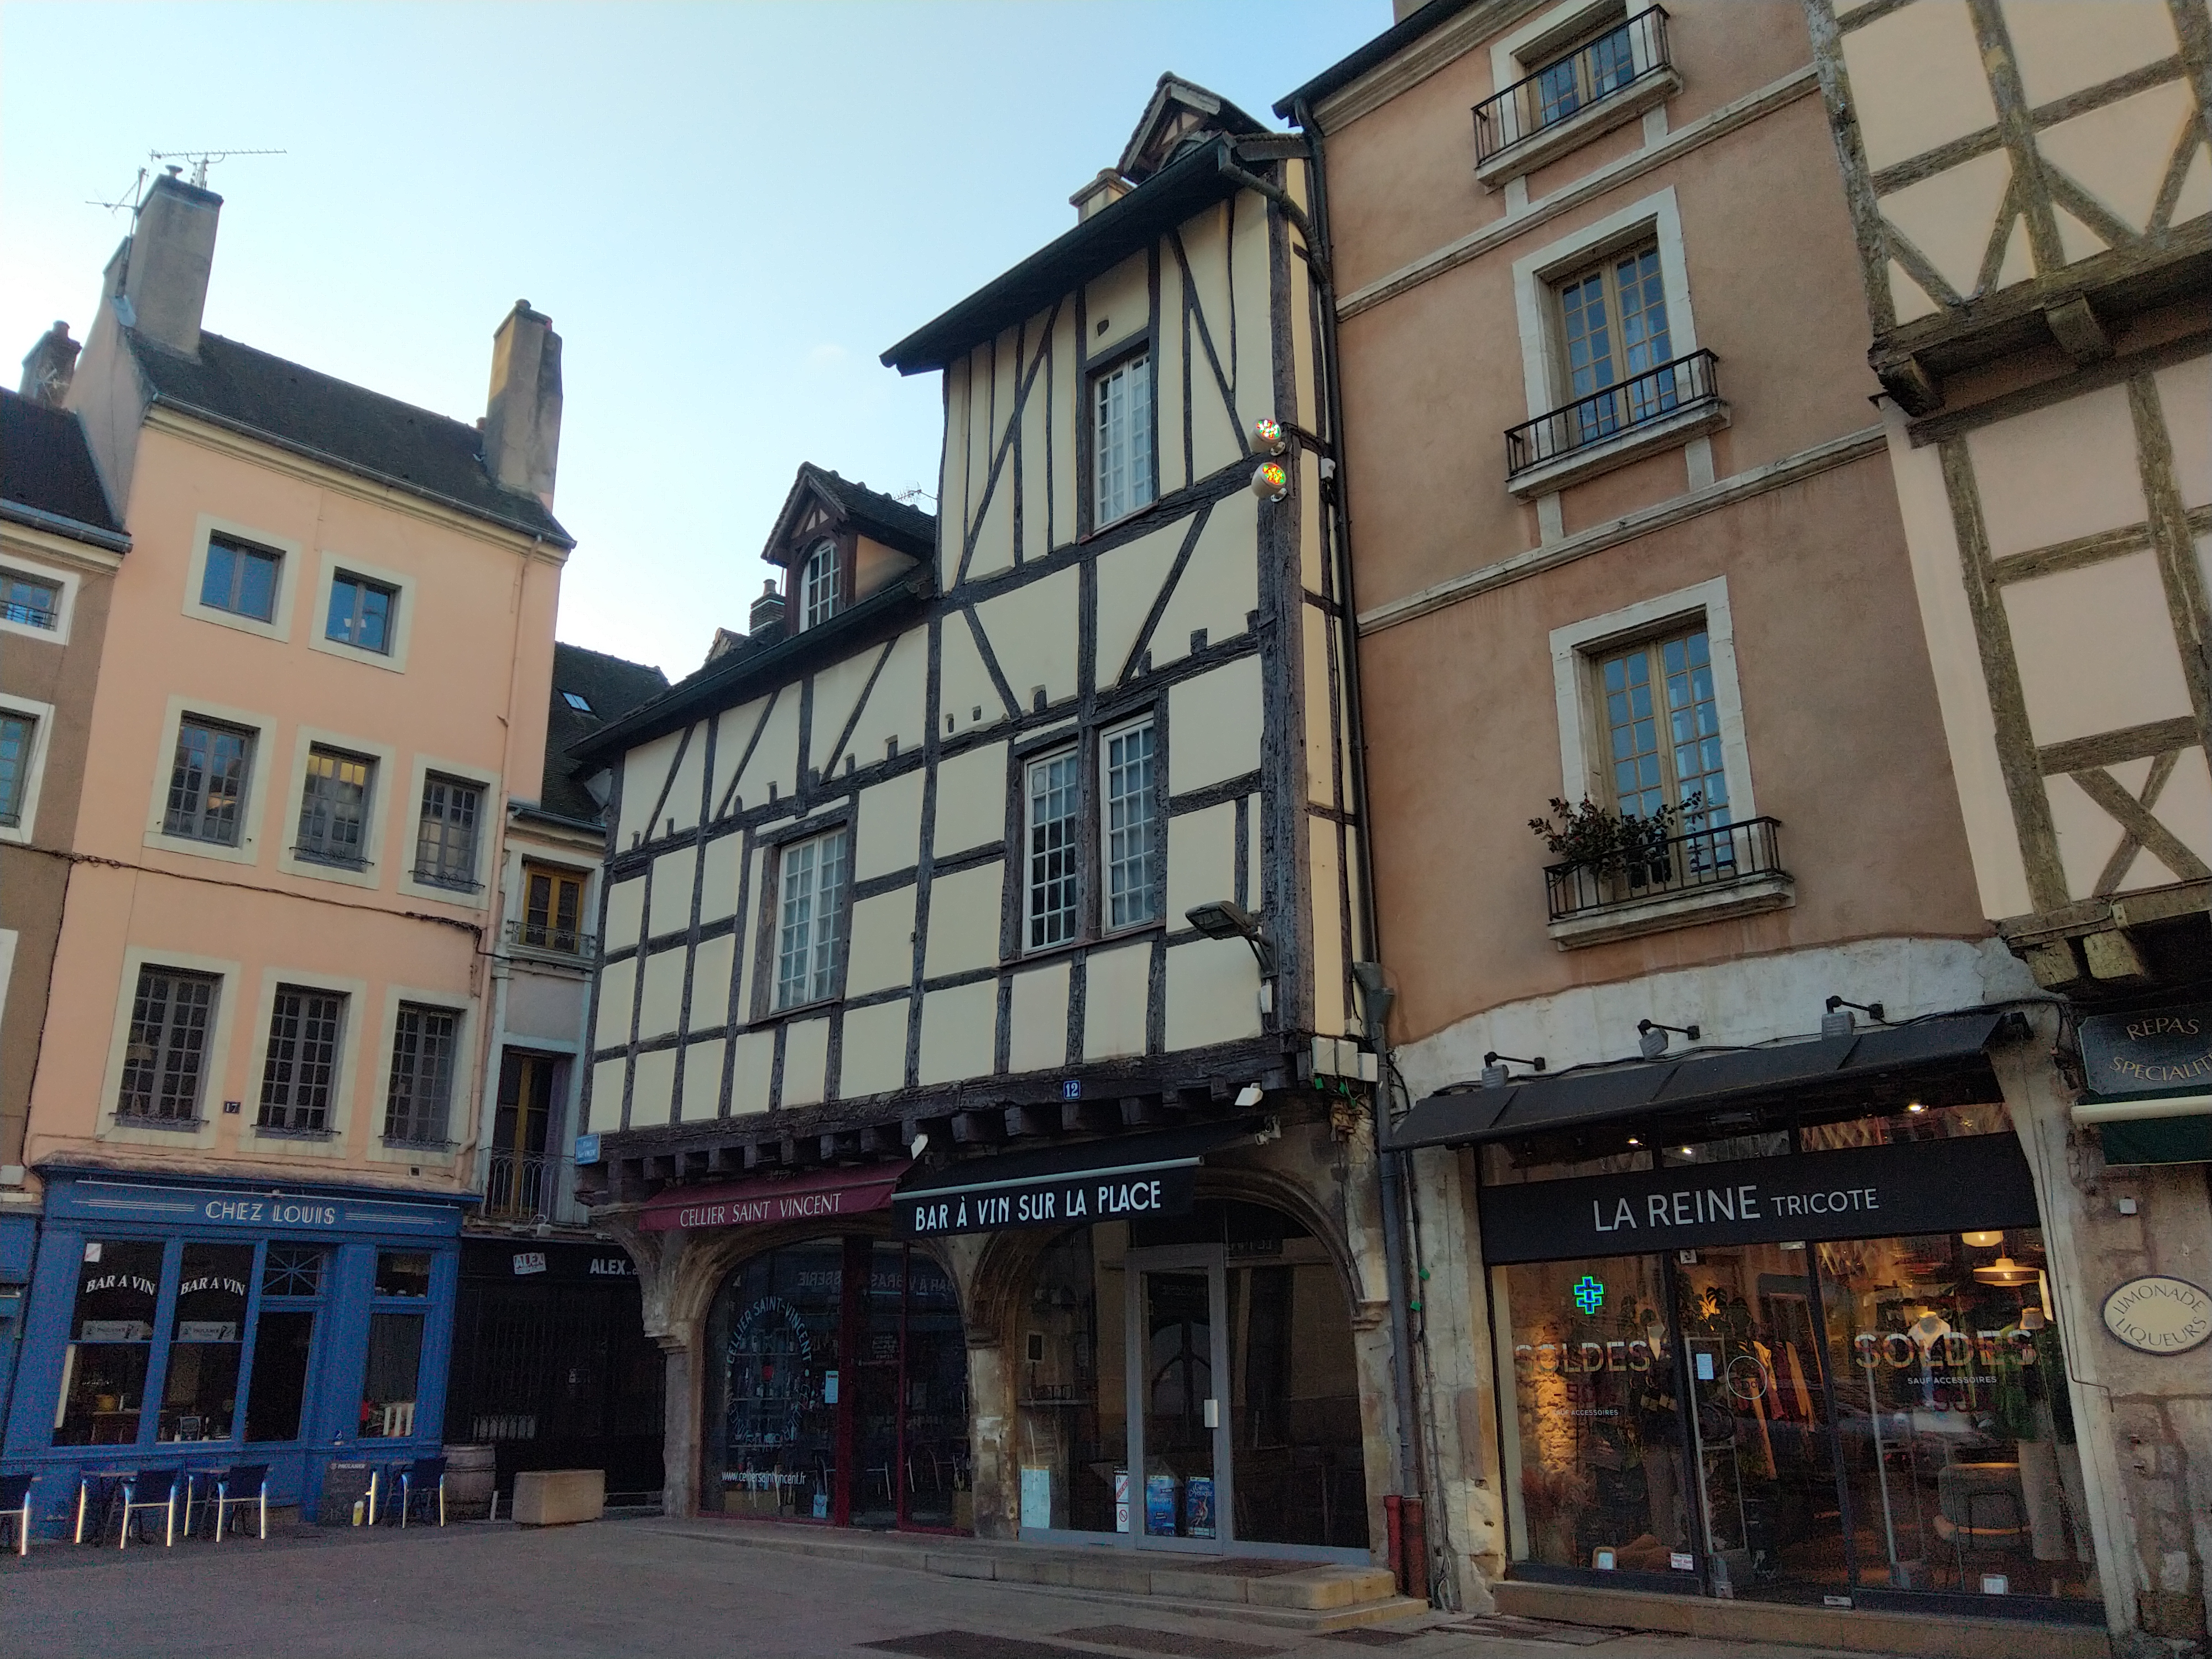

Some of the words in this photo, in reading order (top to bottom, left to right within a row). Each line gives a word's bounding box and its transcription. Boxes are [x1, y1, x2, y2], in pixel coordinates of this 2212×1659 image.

[2126, 1017, 2200, 1040] REPAS
[1066, 1082, 1078, 1098] 12
[226, 1103, 238, 1113] 17
[205, 1201, 263, 1221] CHEZ
[272, 1204, 335, 1225] LOUIS
[680, 1206, 725, 1227] CELLIER
[732, 1201, 771, 1222] SAINT
[779, 1193, 842, 1218] VINCENT
[915, 1204, 948, 1232] BAR
[956, 1196, 967, 1228] À
[977, 1197, 1010, 1225] VIN
[1018, 1192, 1055, 1221] SUR
[1066, 1189, 1087, 1217] LA
[1098, 1181, 1161, 1214] PLACE
[1593, 1197, 1637, 1232] LA
[1647, 1185, 1761, 1227] REINE
[1771, 1188, 1880, 1217] TRICOTE
[589, 1258, 627, 1275] ALEX
[86, 1275, 116, 1293] BAR
[117, 1274, 128, 1287] A
[132, 1276, 156, 1296] VIN
[180, 1277, 209, 1296] BAR
[210, 1277, 219, 1289] A
[223, 1278, 246, 1296] VIN
[2113, 1285, 2206, 1314] LIMONADE
[726, 1310, 752, 1364] CELLIER
[753, 1296, 812, 1361] SAINT-VINCENT
[2115, 1316, 2207, 1347] LIQUEURS
[1515, 1340, 1651, 1373] SOLDES
[1854, 1329, 2037, 1368] SOLDES
[1933, 1376, 1997, 1384] ACCESSOIRES
